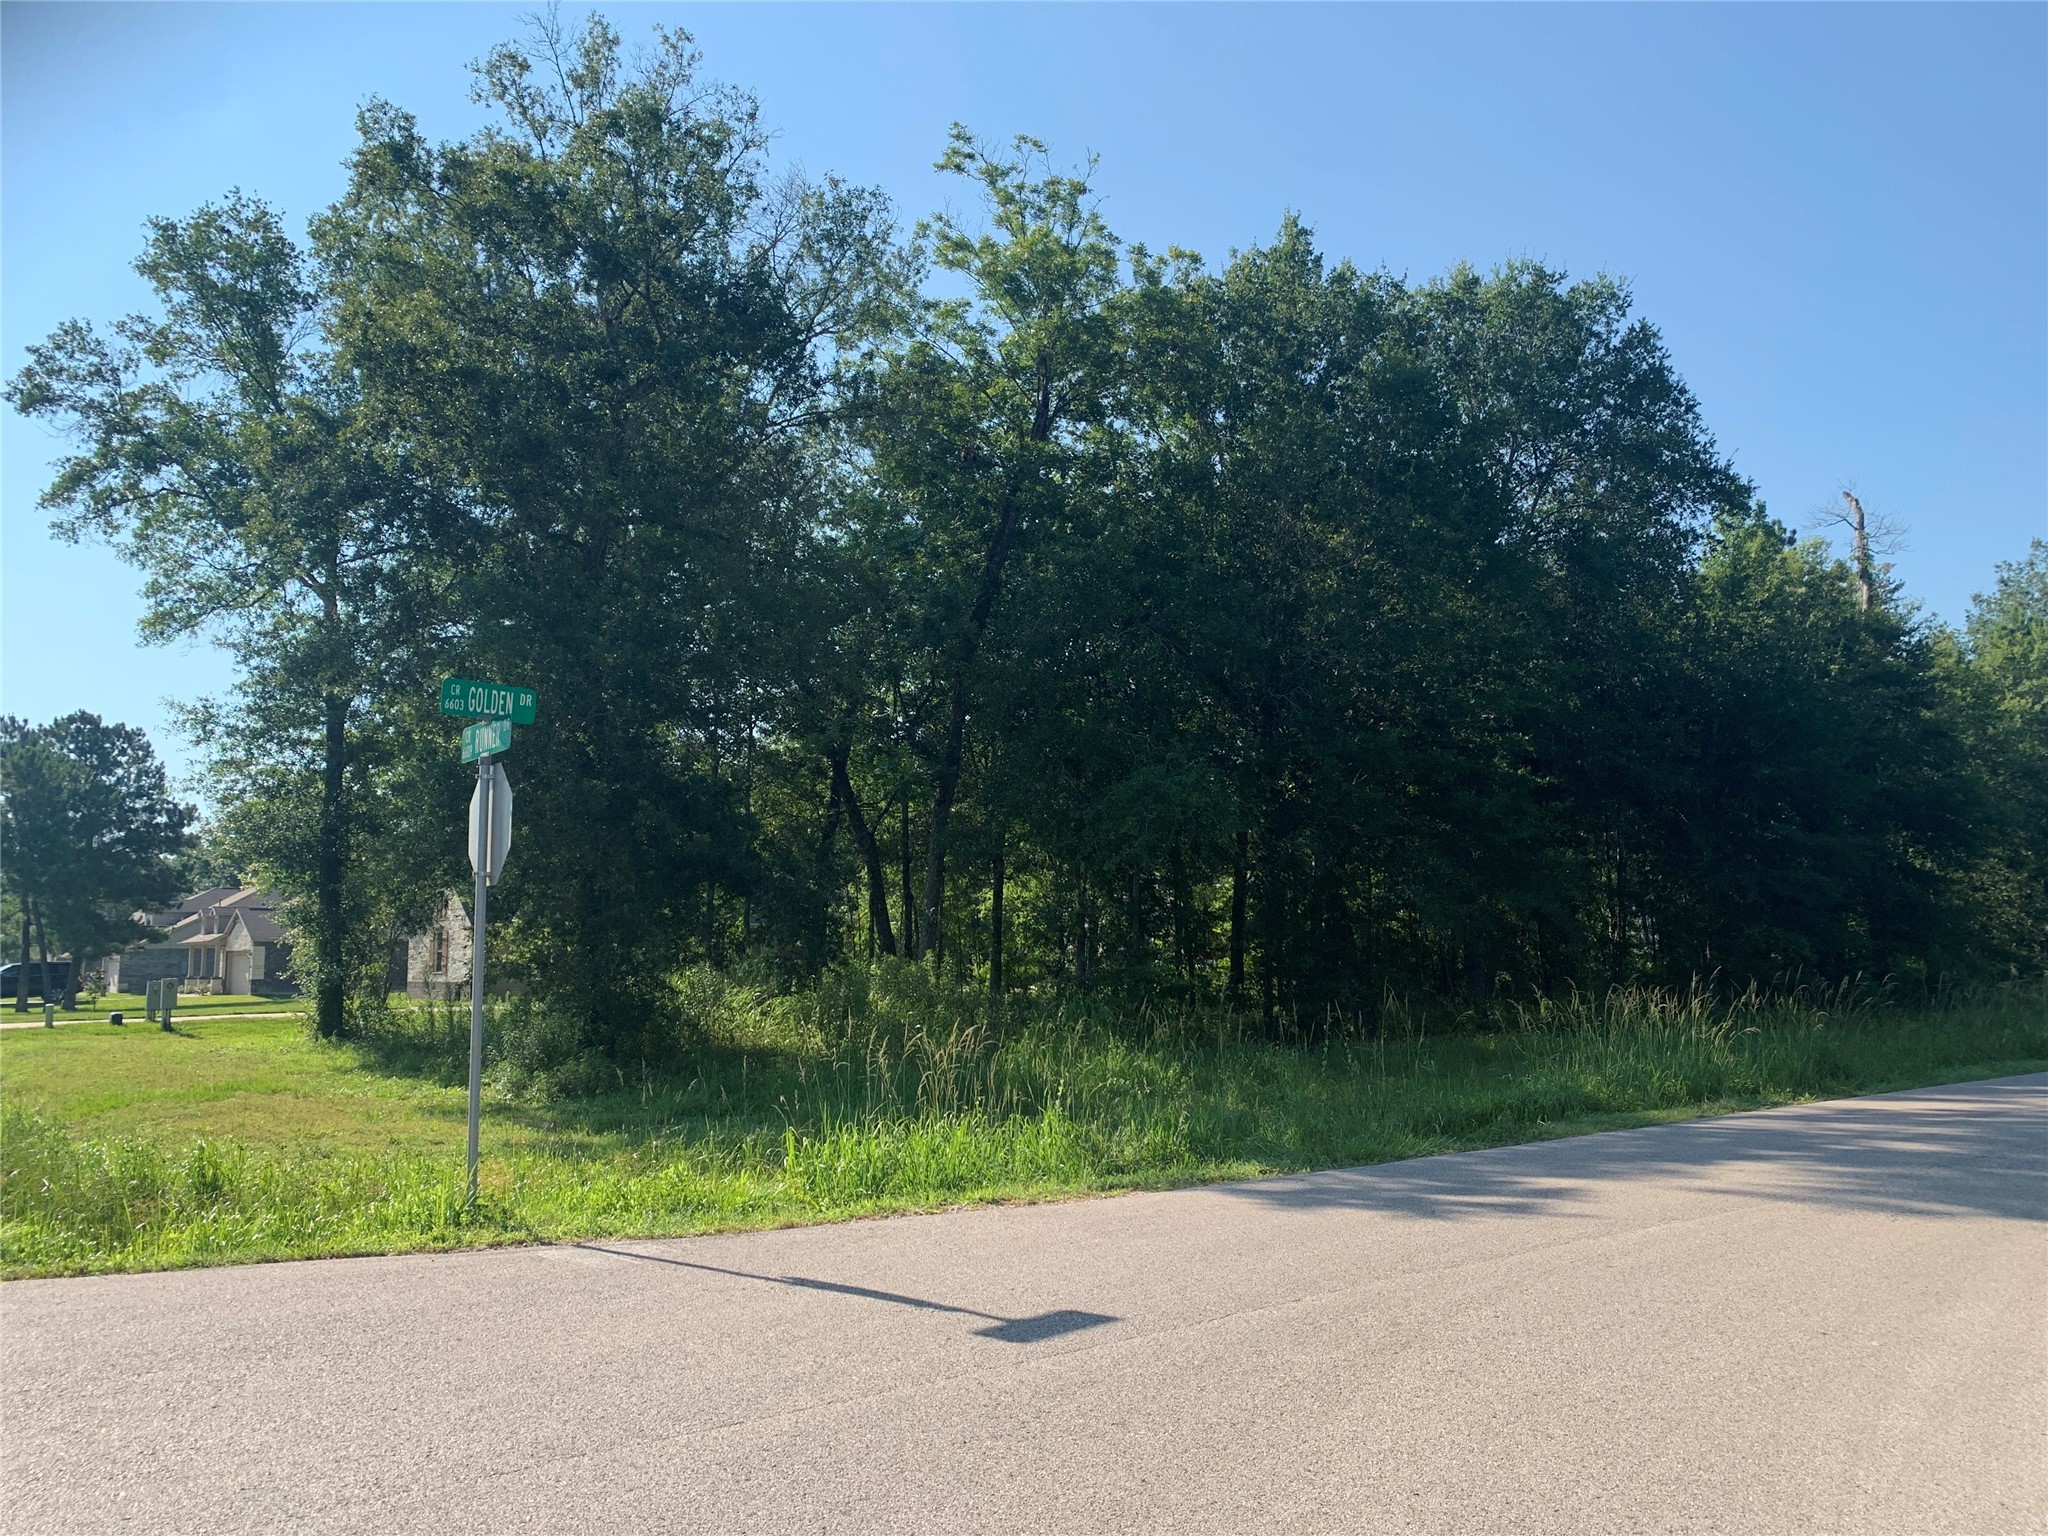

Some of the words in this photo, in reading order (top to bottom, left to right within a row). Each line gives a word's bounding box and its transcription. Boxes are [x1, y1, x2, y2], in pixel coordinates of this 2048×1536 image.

[451, 684, 460, 695] CR
[444, 698, 464, 710] 6603
[468, 686, 513, 715] GOLDEN
[520, 693, 532, 707] DR
